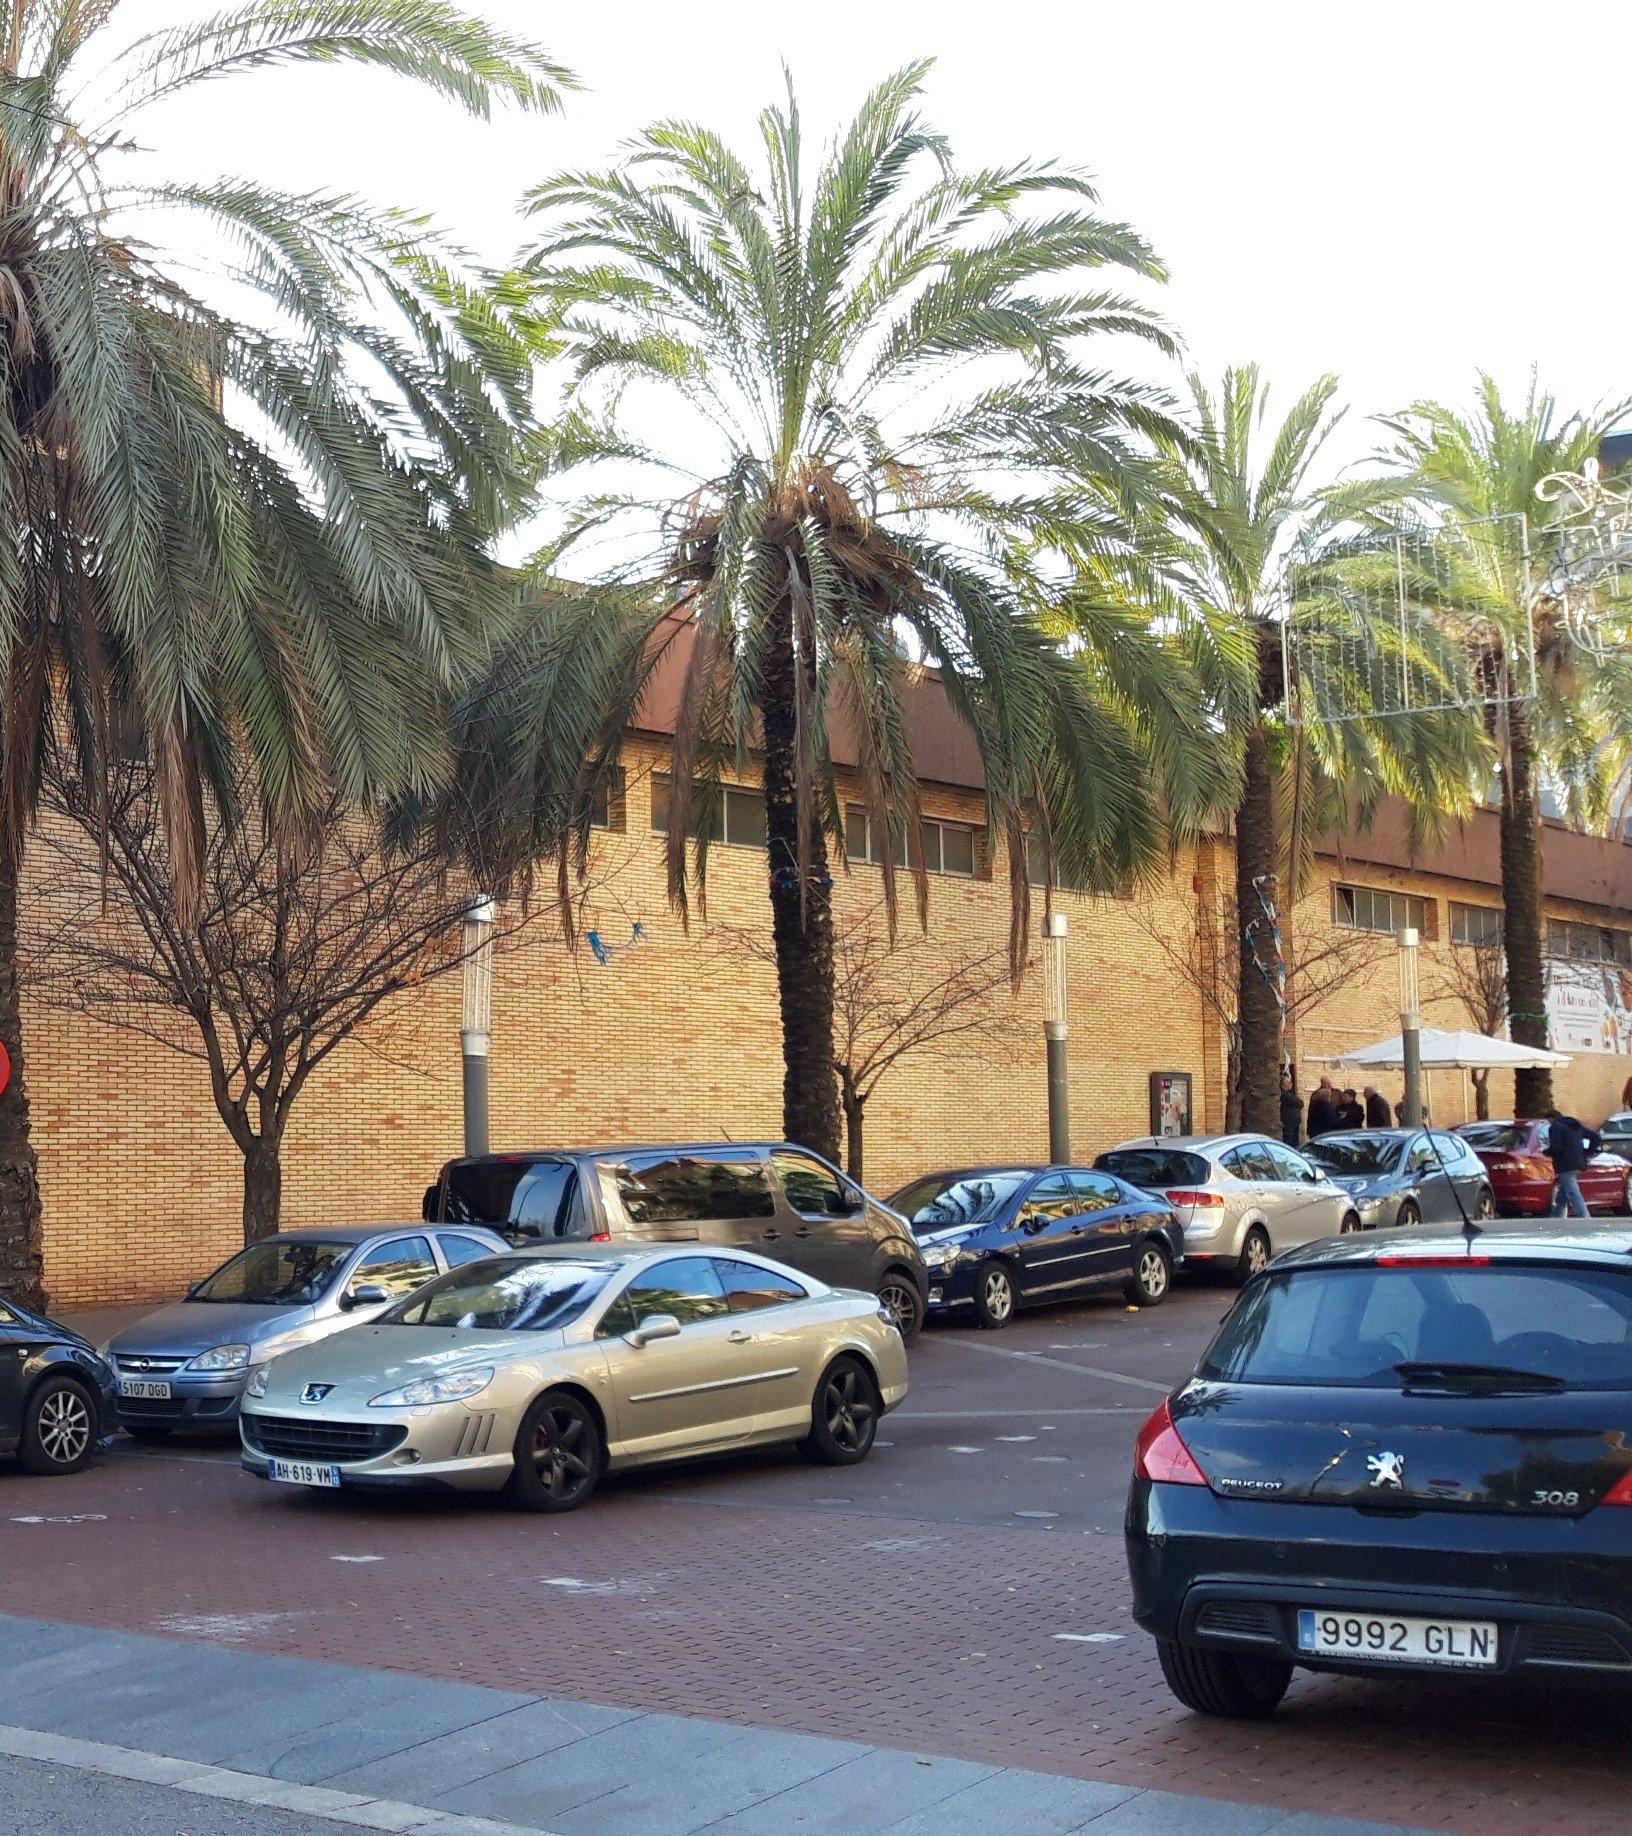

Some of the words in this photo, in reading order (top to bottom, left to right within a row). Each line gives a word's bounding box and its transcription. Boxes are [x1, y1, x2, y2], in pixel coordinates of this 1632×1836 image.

[1221, 1479, 1283, 1489] PEUGEOT
[1530, 1490, 1579, 1506] 308
[1322, 1616, 1408, 1652] 9992
[1424, 1625, 1489, 1658] GLN
